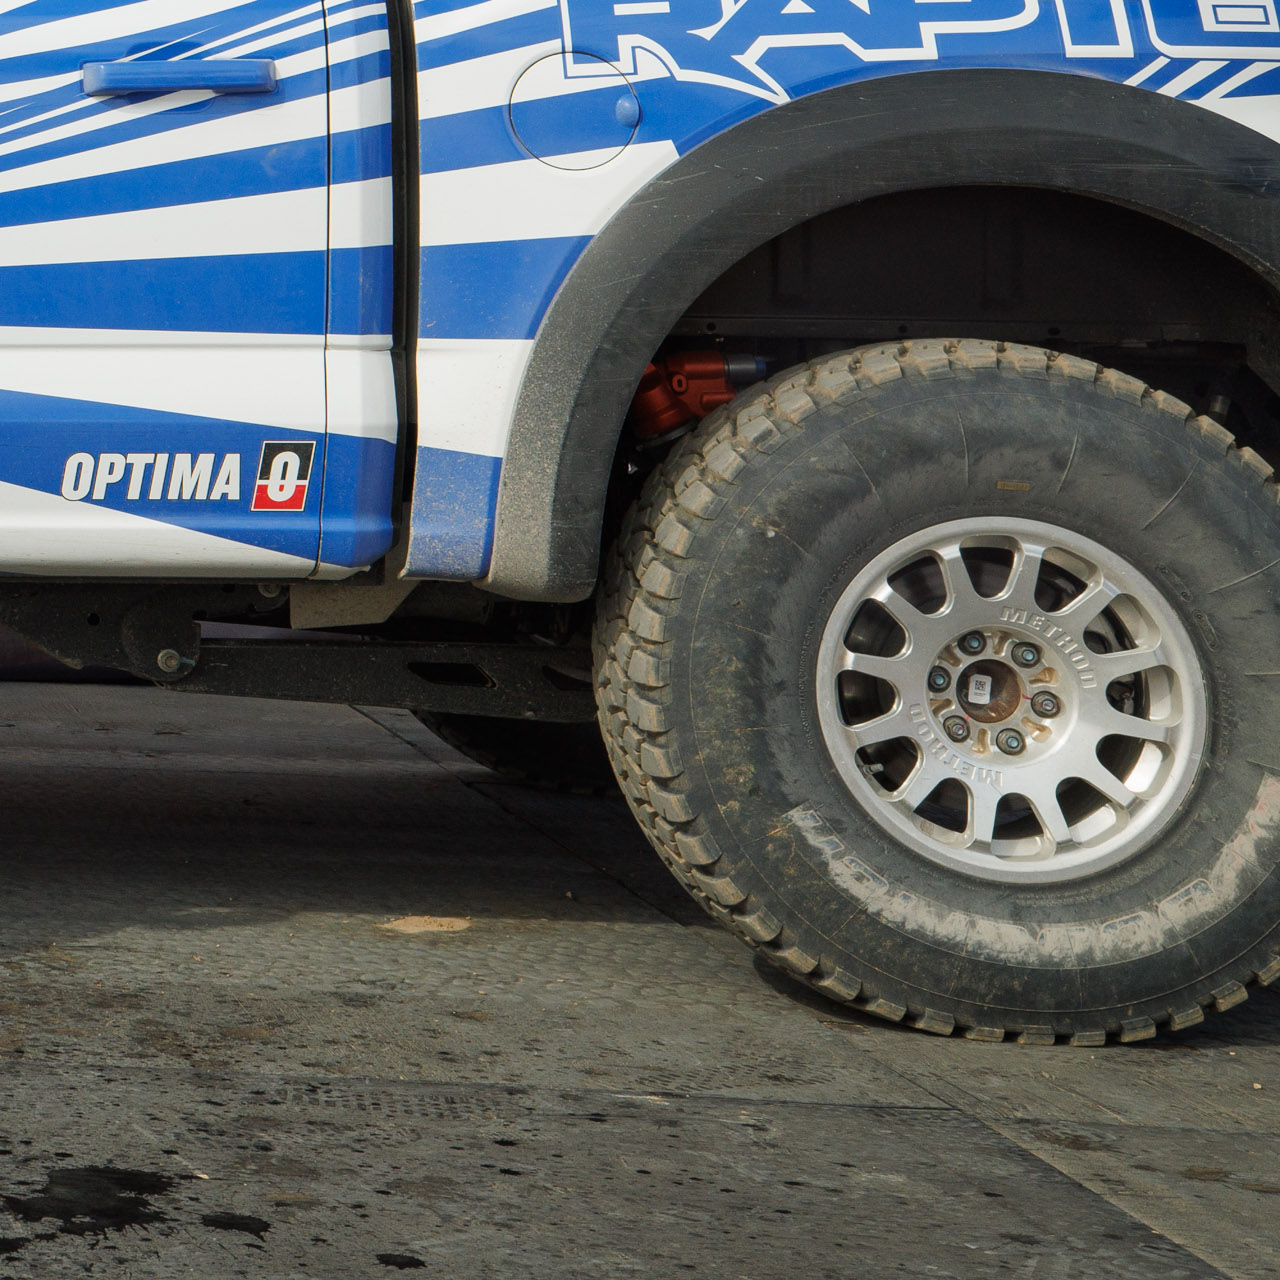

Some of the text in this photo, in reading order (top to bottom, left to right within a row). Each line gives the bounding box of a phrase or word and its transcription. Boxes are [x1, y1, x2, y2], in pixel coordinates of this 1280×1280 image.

[60, 451, 241, 502] OPTIMA
[999, 605, 1097, 689] METHOD
[909, 703, 1004, 787] METHOD
